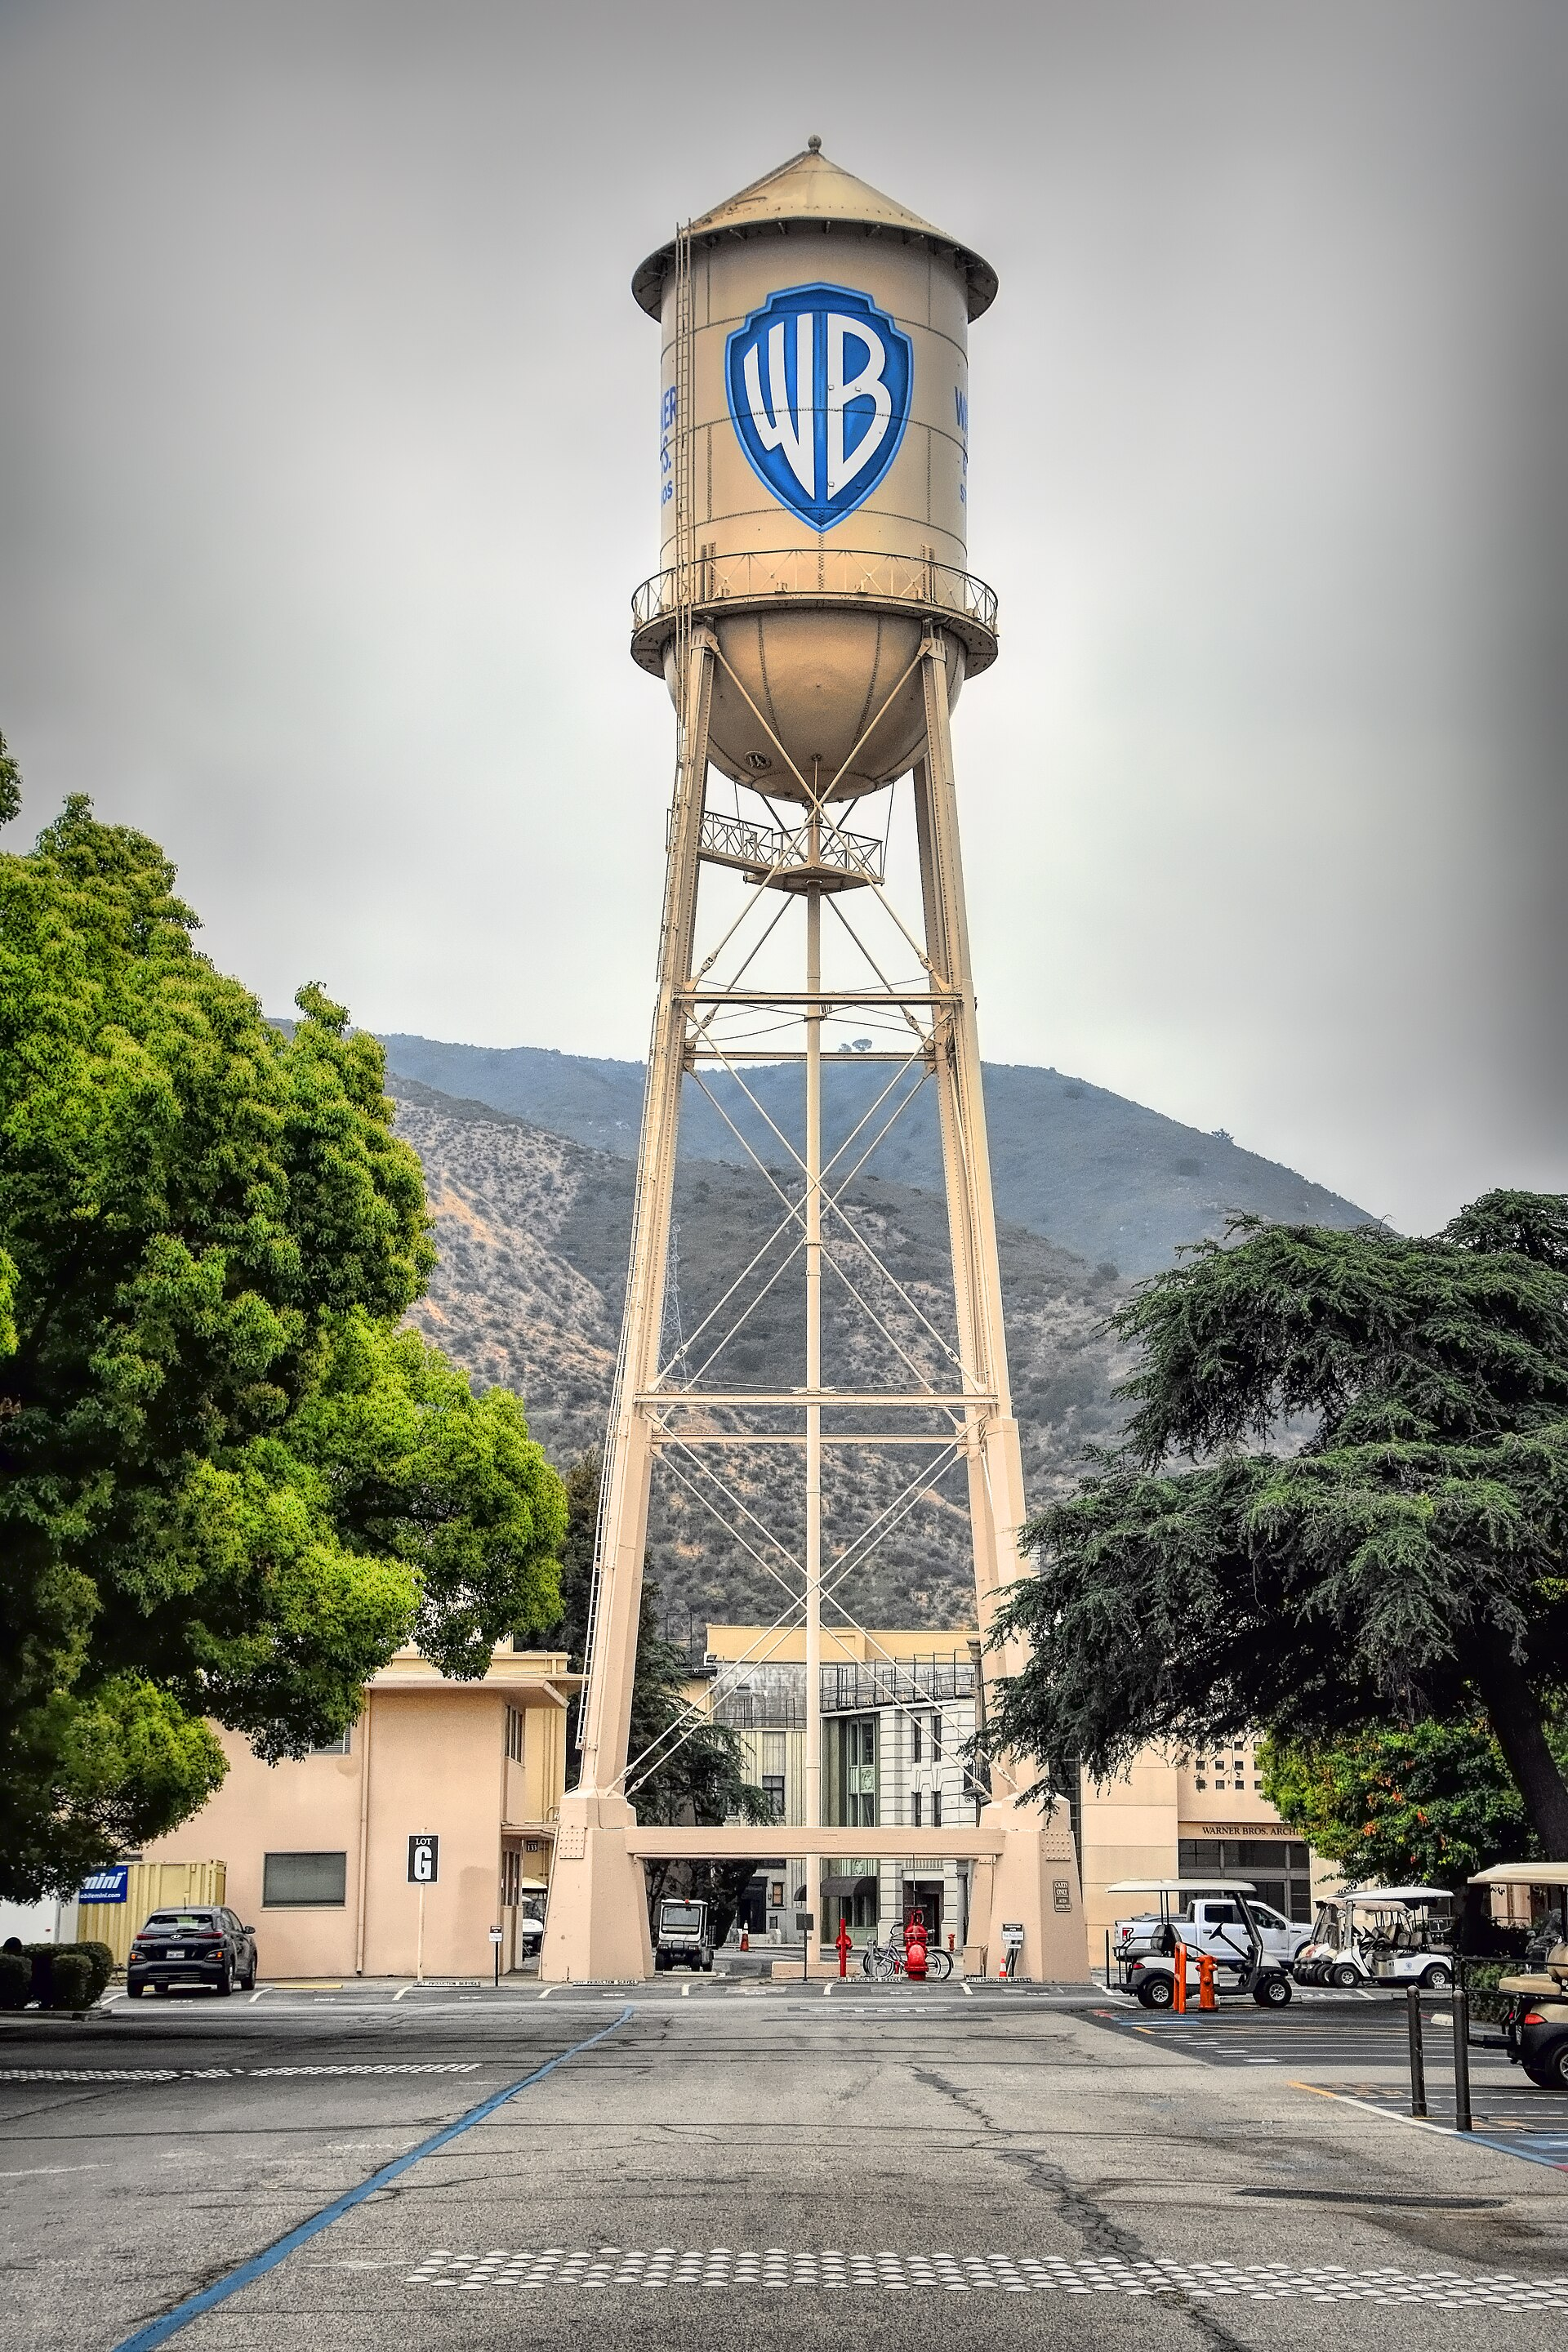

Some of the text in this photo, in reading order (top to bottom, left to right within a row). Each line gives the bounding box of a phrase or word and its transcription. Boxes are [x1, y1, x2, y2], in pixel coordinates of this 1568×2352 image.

[743, 313, 892, 501] WB
[1202, 1826, 1300, 1836] WARNER BROS. ARCHI
[414, 1846, 432, 1880] G
